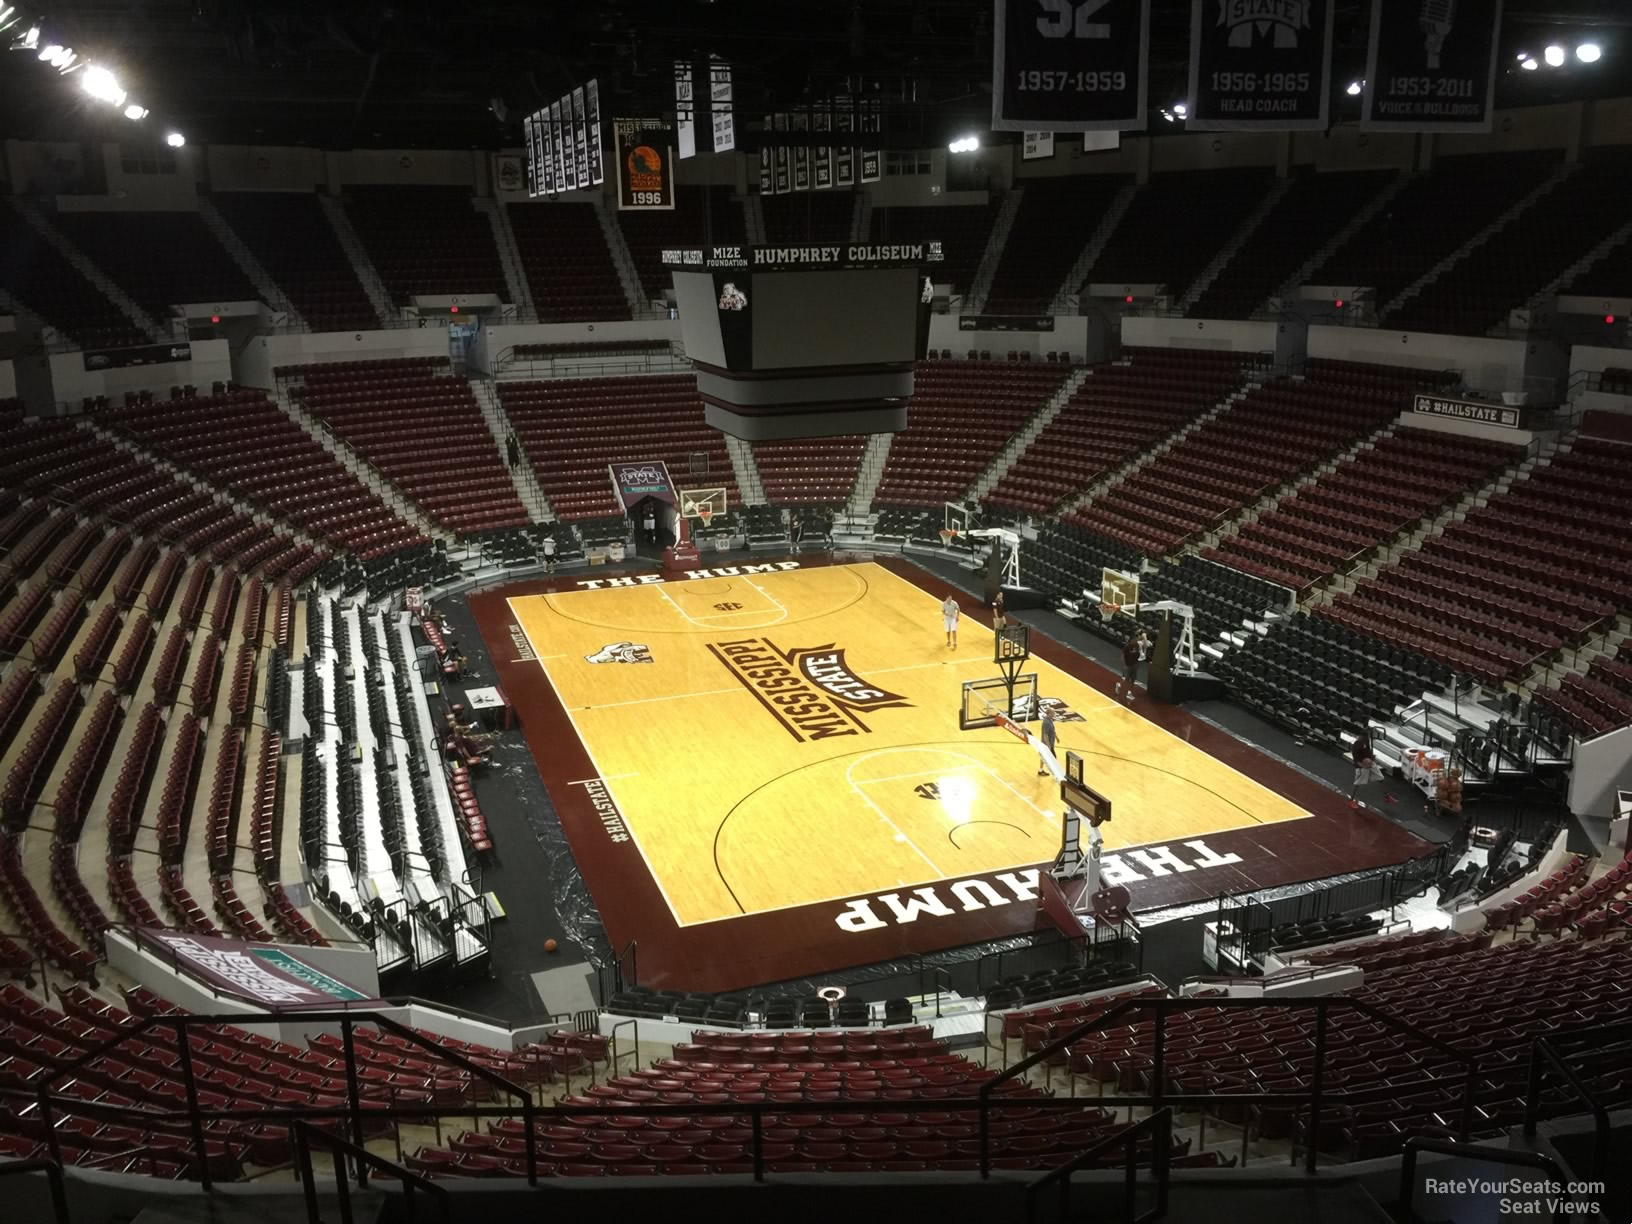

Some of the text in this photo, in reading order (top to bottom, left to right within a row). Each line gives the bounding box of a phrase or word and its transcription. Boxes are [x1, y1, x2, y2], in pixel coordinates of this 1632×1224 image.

[1233, 0, 1295, 21] STATE
[1018, 70, 1126, 91] 1957-1959
[1211, 71, 1310, 92] 1956-1965
[1388, 77, 1473, 97] 1953-2011
[1220, 99, 1297, 112] HEAD COACH
[1379, 101, 1413, 115] VOICE
[1423, 102, 1480, 116] BULLDOGS
[632, 192, 662, 205] 1996
[706, 259, 748, 267] FOUNDATION
[713, 247, 741, 259] MIZE
[754, 245, 923, 264] HUMPHREY COLISEUM
[1433, 403, 1498, 421] #HAILSTATE
[577, 561, 801, 590] THE HUMP
[713, 602, 744, 611] SEC
[805, 653, 886, 701] STATE
[717, 638, 860, 742] MISSISSIPPI
[583, 780, 630, 843] #HAILSTATE
[835, 839, 1245, 933] THE HUMP
[158, 935, 299, 1003] MISSISSIPPI
